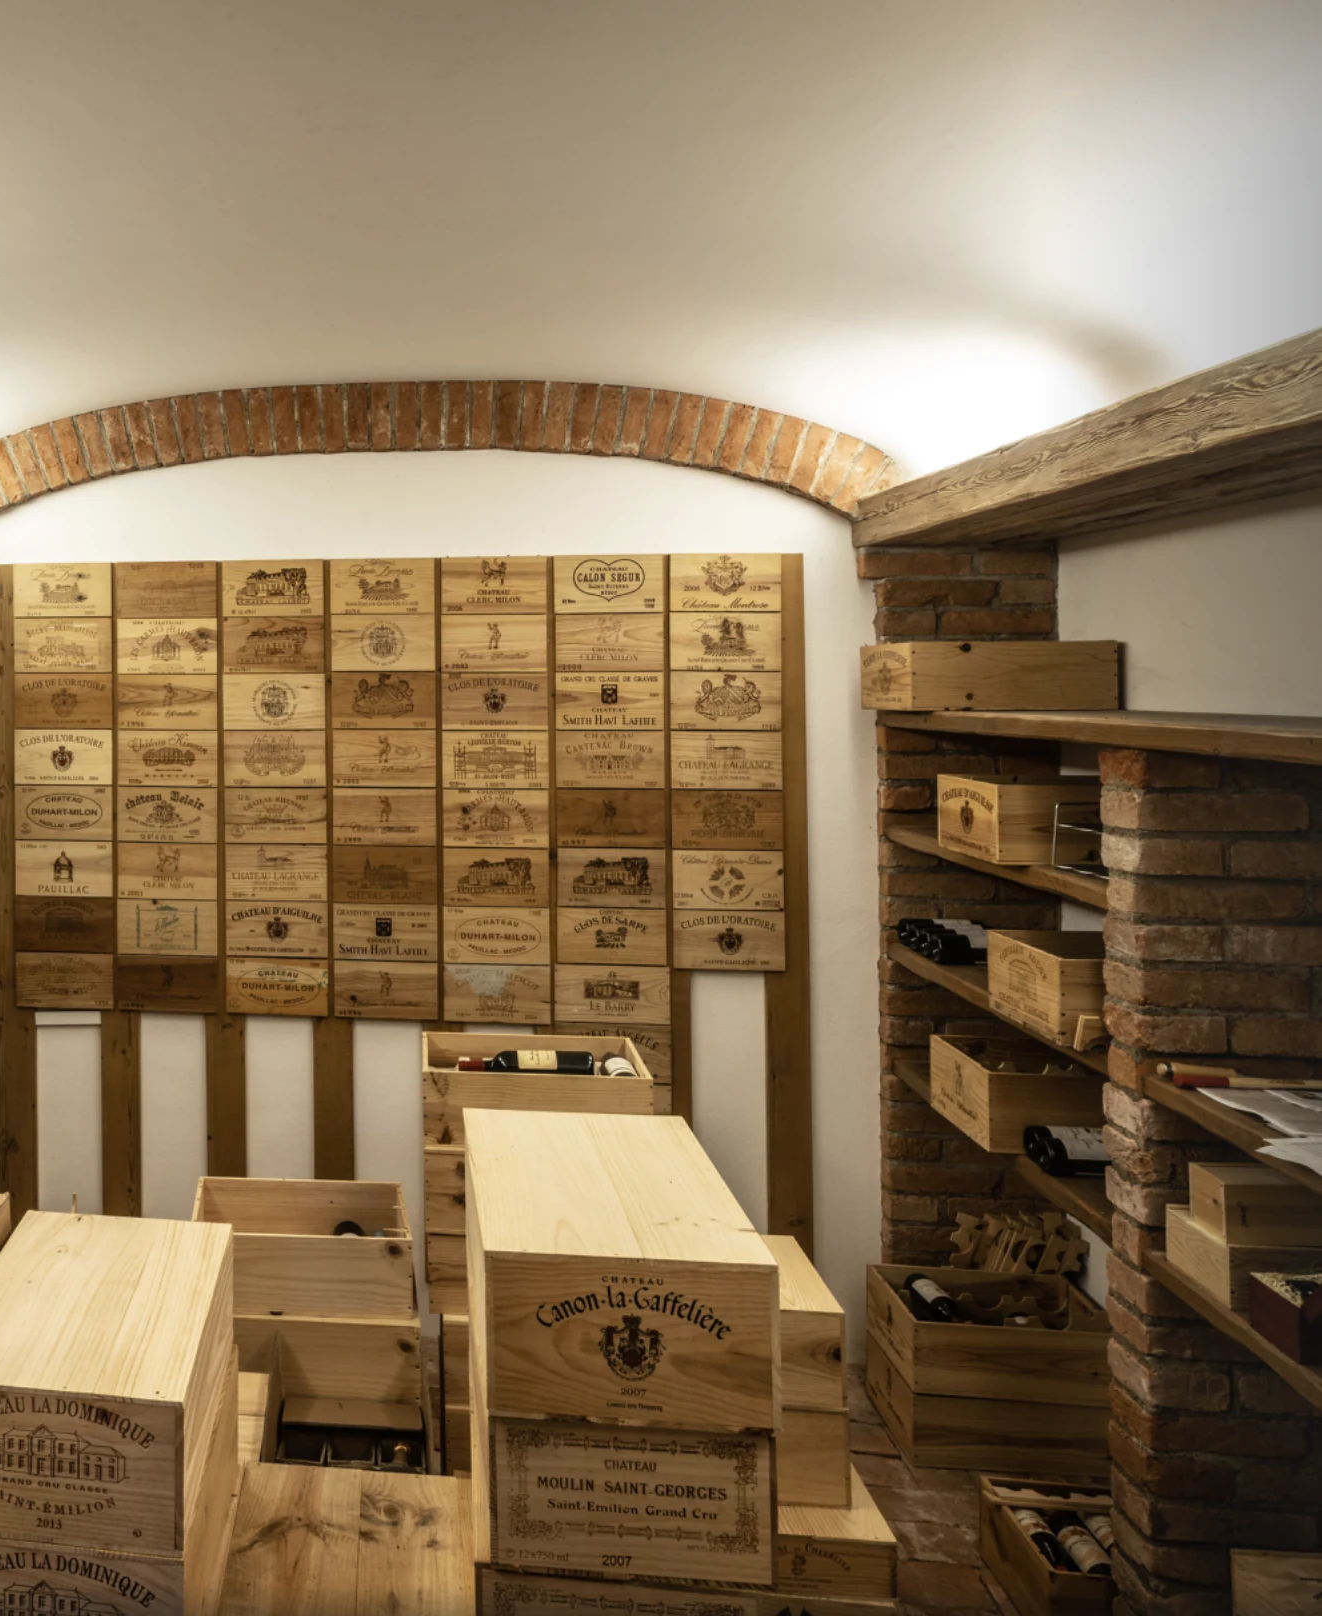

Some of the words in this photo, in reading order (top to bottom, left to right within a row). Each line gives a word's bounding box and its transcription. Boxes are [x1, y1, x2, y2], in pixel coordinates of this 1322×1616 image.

[577, 573, 605, 582] CALON
[611, 573, 641, 582] SEGUR
[466, 596, 494, 604] CLERC
[681, 597, 720, 608] Château
[724, 597, 768, 608] Montrose
[21, 682, 43, 692] CLOS
[58, 678, 107, 692] L'ORATOIRE
[448, 681, 470, 692] CLOS
[472, 679, 485, 688] DE
[487, 678, 540, 692] L'ORATOIRE
[562, 715, 592, 726] SMITH
[19, 737, 41, 748] CLOS
[43, 735, 54, 743] DE
[56, 734, 105, 748] L'ORATOIRE
[566, 742, 613, 754] CANTENAC
[619, 741, 653, 754] BROWN
[678, 760, 718, 769] CHATEAU
[723, 760, 773, 769] LAGRANGE
[45, 796, 83, 804] CHATEAU
[31, 808, 98, 816] DUHART-MILON
[231, 872, 271, 880] CHATEAU
[273, 872, 319, 880] LAGRANGE
[37, 884, 89, 894] PAUILLAC
[231, 907, 271, 922] CHATEAU
[273, 906, 323, 924] D'AIGUILHE
[476, 919, 519, 928] CHATEAU
[574, 919, 600, 934] CLOS
[602, 916, 613, 925] DE
[615, 917, 649, 934] SARPE
[680, 918, 704, 929] CLOS
[722, 916, 777, 932] L'ORATOIRE
[460, 932, 536, 941] DUHART-MILON
[339, 944, 367, 955] SMITH
[467, 943, 498, 954] PAUILLAC
[504, 945, 526, 954] MEDOC
[258, 970, 299, 979] CHATEAU
[241, 982, 315, 992] DUHART-MILON
[249, 994, 279, 1004] PAUILLAC
[604, 1000, 636, 1012] BARRY
[601, 1275, 665, 1286] CHATEAU
[620, 1388, 647, 1396] 2007
[31, 1397, 52, 1414] LA
[55, 1398, 157, 1450] DOMINIQUE
[604, 1459, 658, 1473] CHATEAU
[37, 1480, 60, 1489] CRU
[537, 1475, 595, 1493] MOULIN
[547, 1498, 639, 1516] Saint-Emilion
[644, 1504, 687, 1519] Grand
[691, 1507, 718, 1520] Cru
[36, 1517, 63, 1530] 2013
[601, 1553, 633, 1567] 2007
[31, 1552, 53, 1571] LA
[56, 1555, 157, 1609] DOMINIQUE
